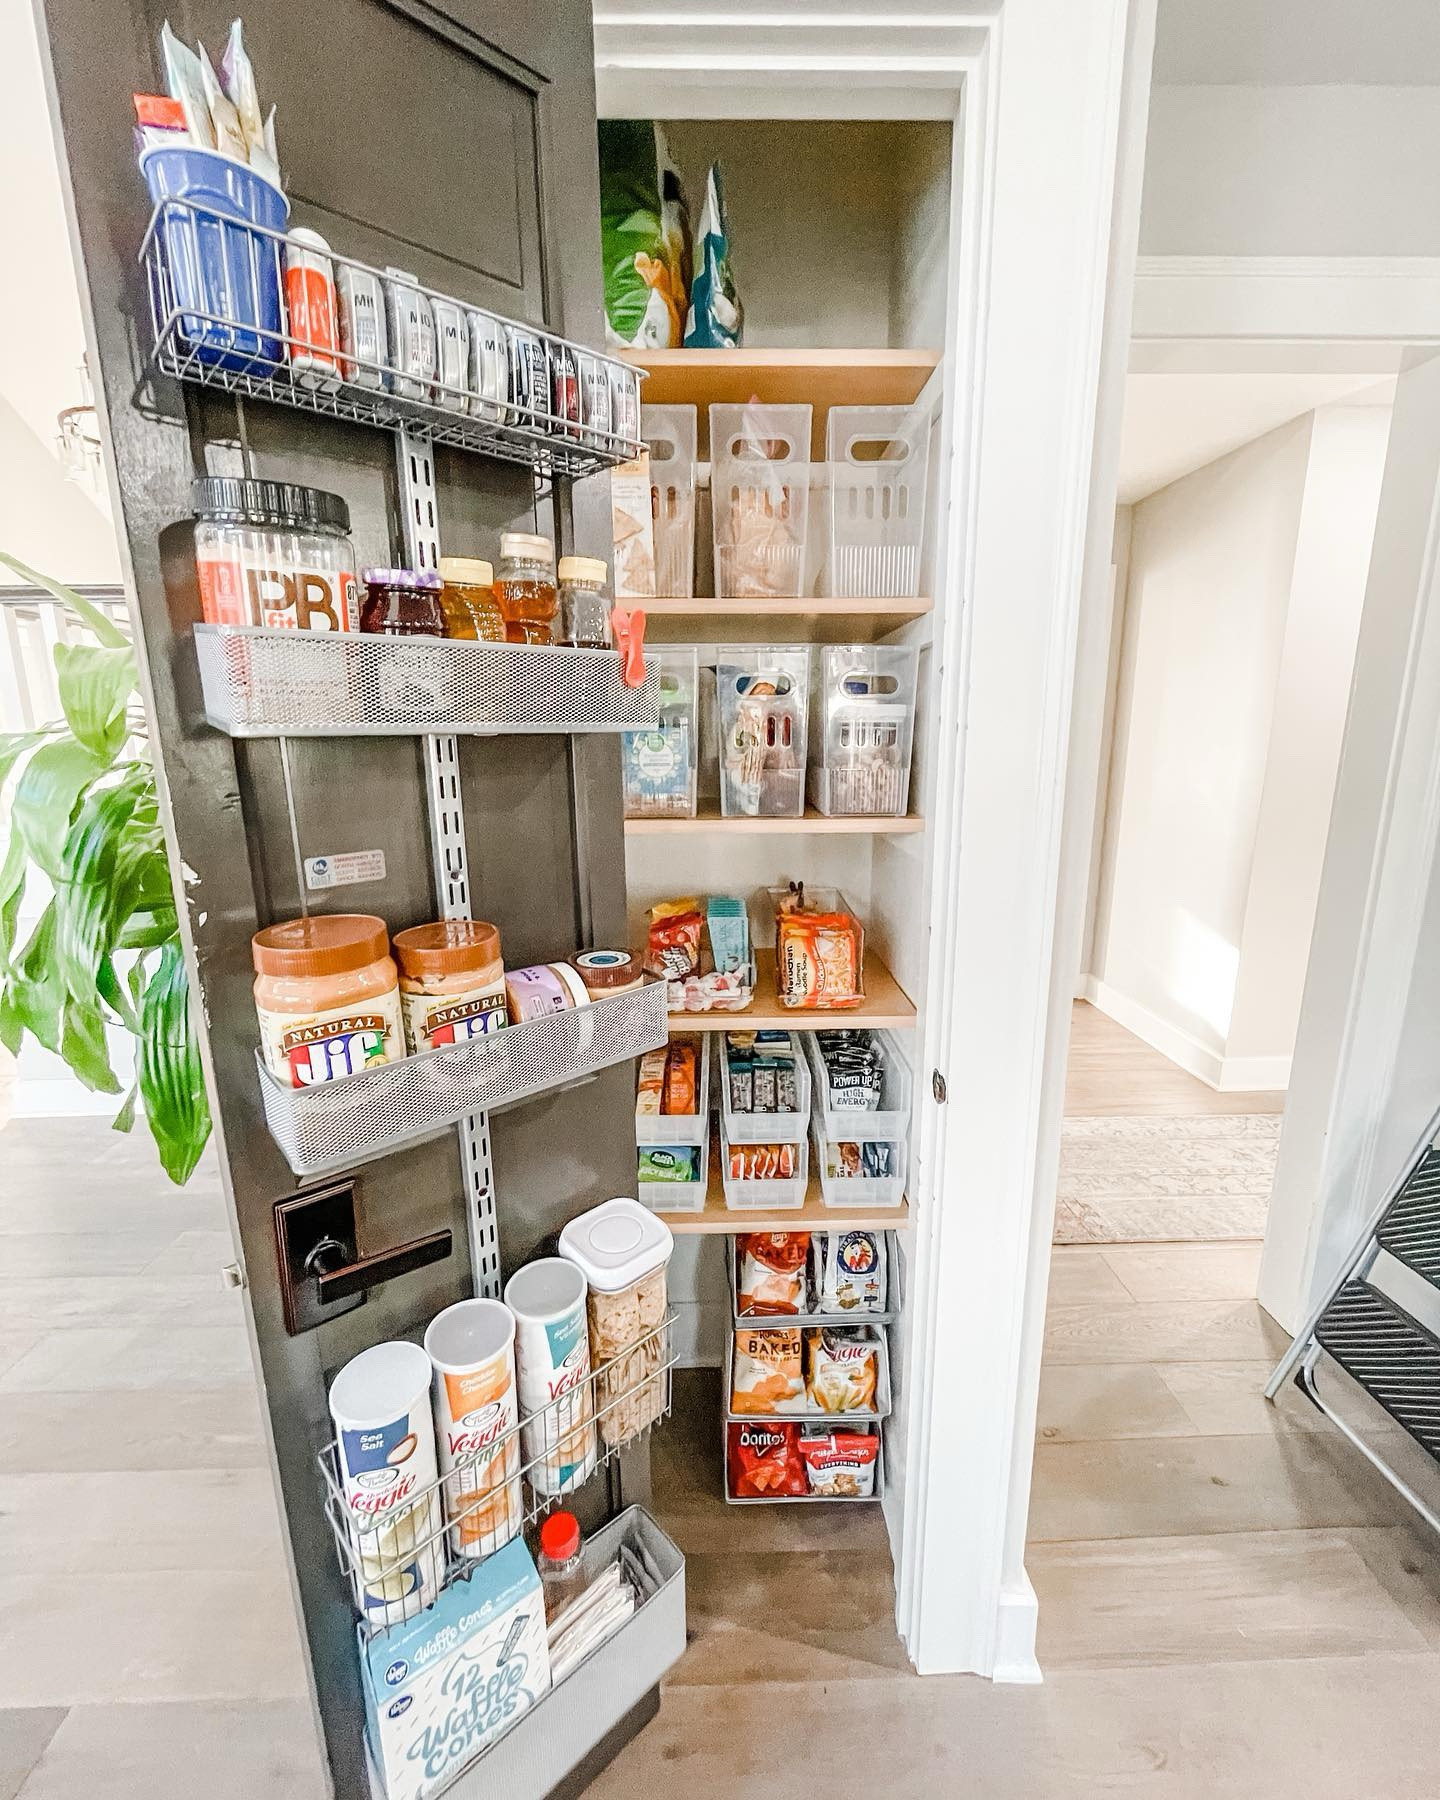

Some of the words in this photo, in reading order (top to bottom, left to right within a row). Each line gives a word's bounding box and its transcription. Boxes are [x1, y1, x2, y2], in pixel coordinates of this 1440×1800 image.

[246, 568, 340, 631] PB
[267, 611, 297, 630] fit
[786, 945, 794, 996] Maruchan
[435, 994, 504, 1023] NATURAL
[289, 1016, 376, 1043] NATURAL
[295, 1030, 379, 1086] Jif
[833, 1075, 860, 1088] POWER
[861, 1075, 873, 1088] UP
[837, 1097, 871, 1106] ENERGY
[749, 1340, 801, 1355] BAKED
[360, 1433, 383, 1443] Sea
[361, 1440, 384, 1451] Salt
[740, 1432, 785, 1446] Doritos
[414, 1625, 457, 1664] Waffle
[459, 1600, 494, 1632] Cones
[450, 1663, 483, 1703] 12
[406, 1663, 524, 1762] Waffle
[424, 1690, 520, 1780] Cones
